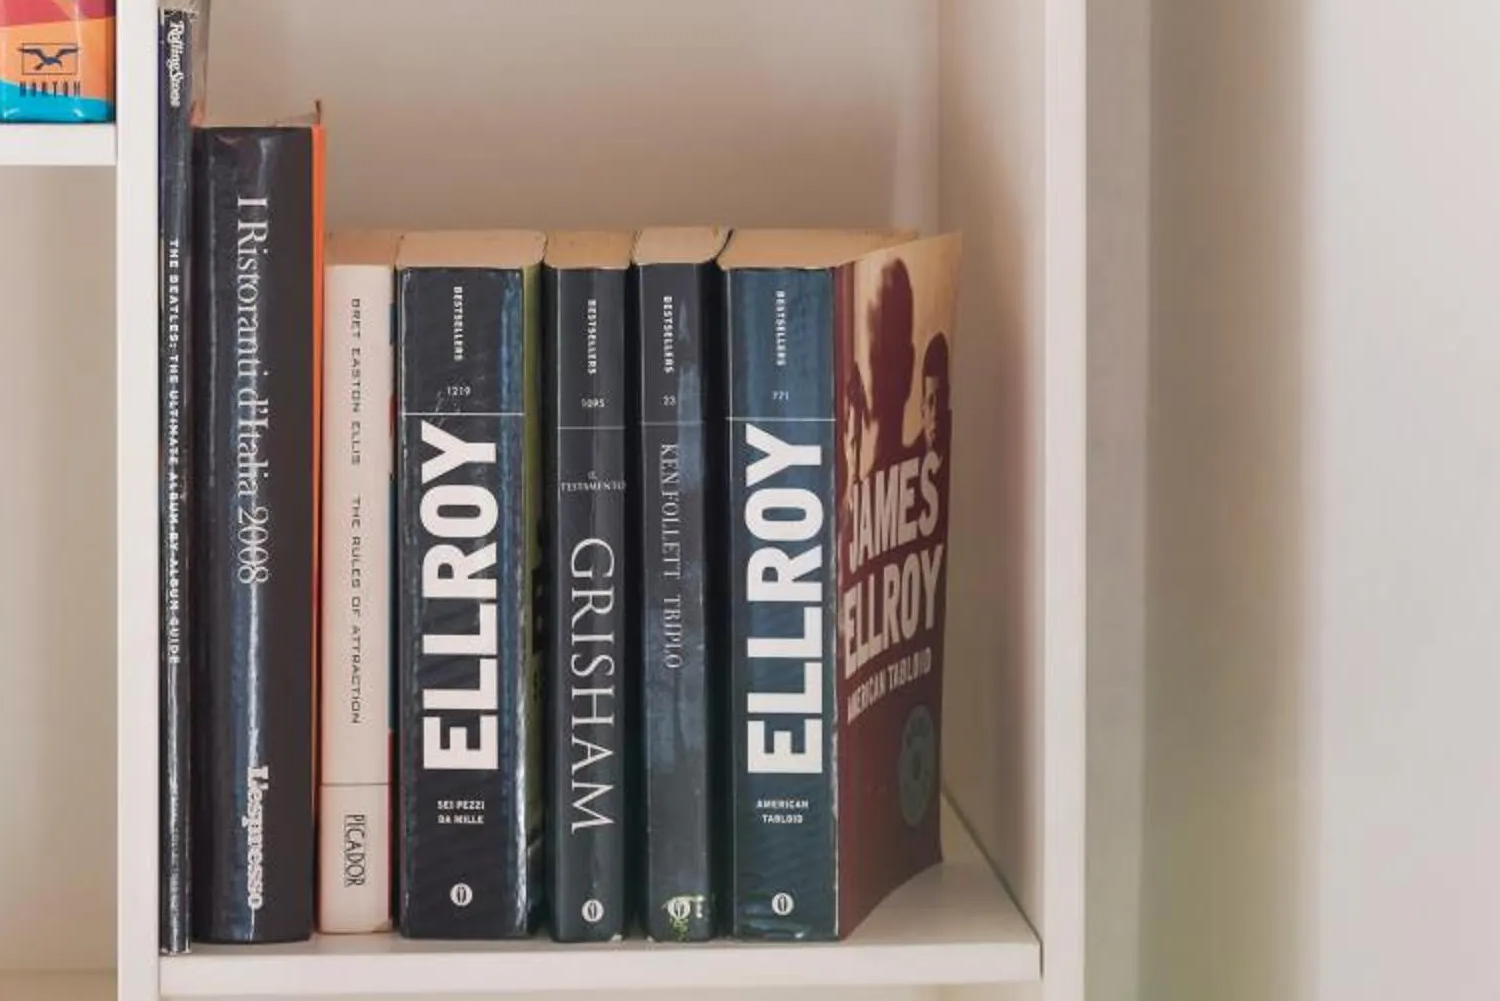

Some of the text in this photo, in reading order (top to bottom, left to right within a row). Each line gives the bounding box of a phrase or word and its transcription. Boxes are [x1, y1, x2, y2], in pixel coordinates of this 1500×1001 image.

[169, 239, 180, 268] THE
[169, 274, 180, 349] BEATLES:
[169, 355, 180, 384] THE
[169, 390, 180, 464] ULTIMATE
[237, 196, 269, 585] I Ristoranti d'Italia 2008
[351, 298, 362, 725] BRET EASTON ELLIS THE RULES OF ATTRACTION
[660, 443, 683, 670] KEN FOLLETT TRIPLO
[848, 450, 944, 575] JAMES
[169, 618, 180, 664] GUIDE
[420, 420, 498, 770] ELLROY
[745, 423, 823, 774] ELLROY
[844, 544, 944, 680] ELLROY
[570, 537, 616, 835] GRISHAM
[343, 814, 366, 889] PICADOR
[756, 799, 810, 809] AMERICAN
